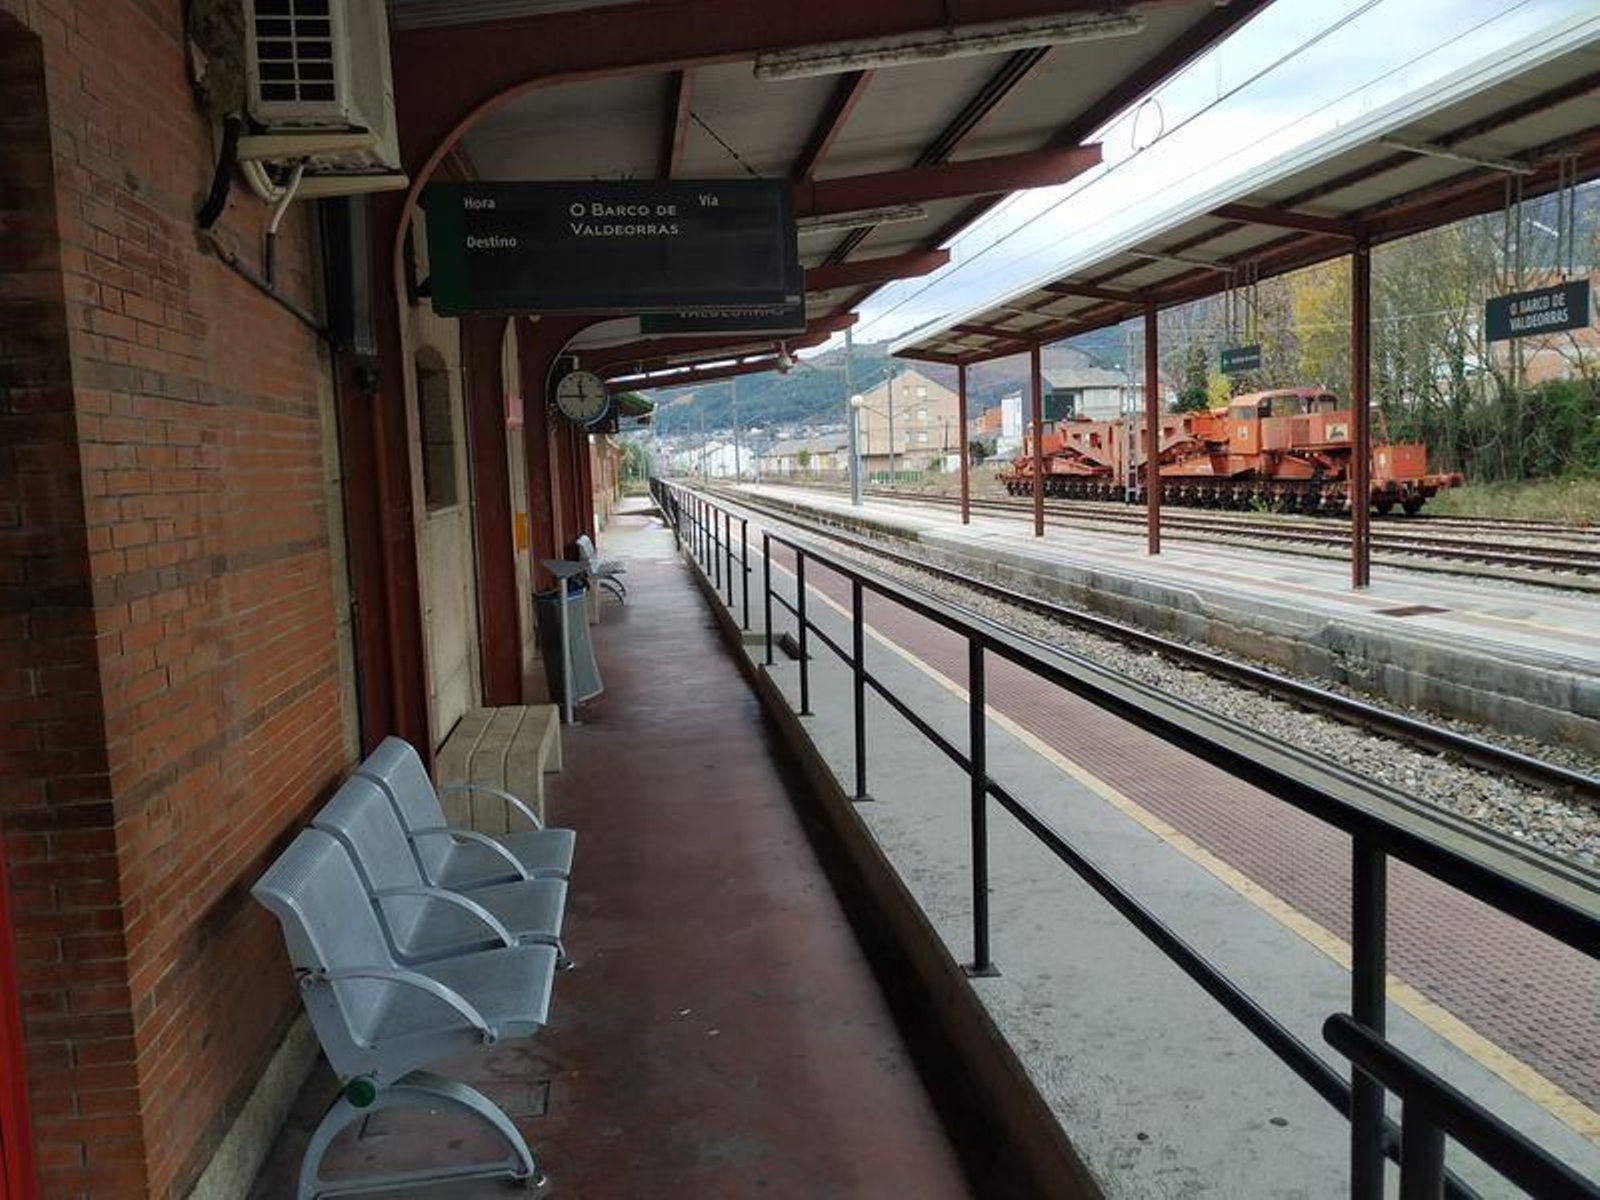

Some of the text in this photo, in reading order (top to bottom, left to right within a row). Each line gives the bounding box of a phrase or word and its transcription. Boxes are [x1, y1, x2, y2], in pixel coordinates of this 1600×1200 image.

[463, 196, 496, 210] Hora
[569, 202, 586, 217] O
[591, 202, 650, 217] BARCO
[570, 222, 679, 237] VALDEORRAS
[466, 234, 517, 249] Destino
[1552, 292, 1566, 307] DE
